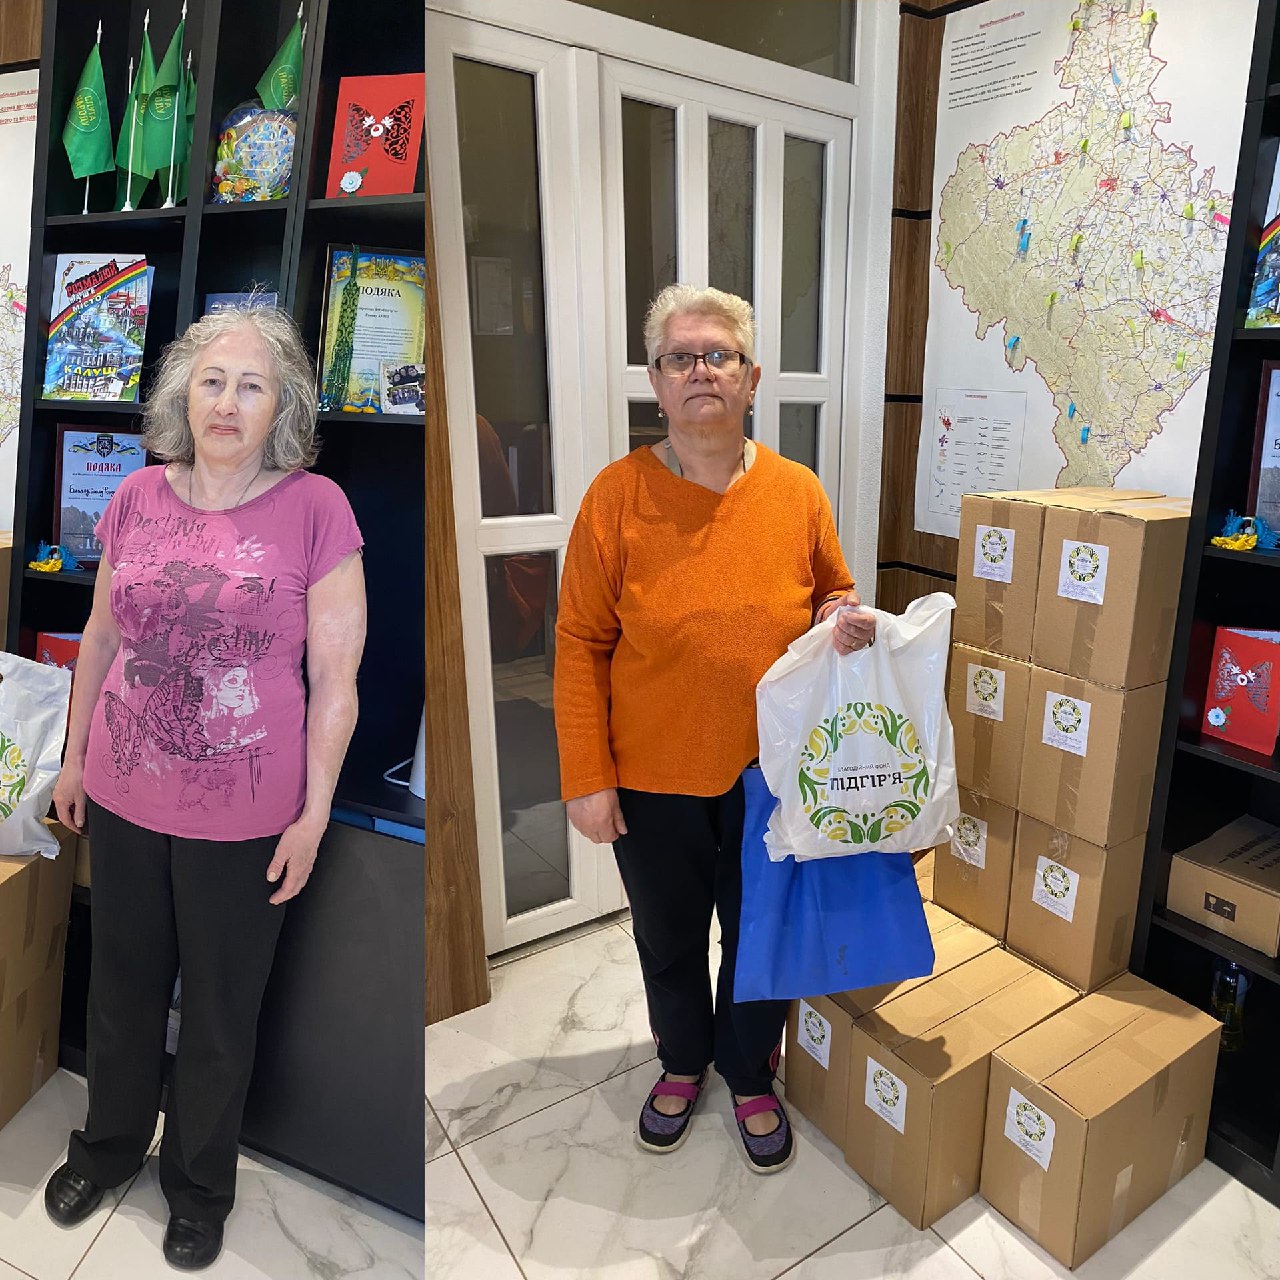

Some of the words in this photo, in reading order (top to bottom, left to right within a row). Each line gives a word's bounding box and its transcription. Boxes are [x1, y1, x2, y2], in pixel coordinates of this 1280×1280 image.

[66, 262, 119, 297] РОЗМАЛЮЙ
[64, 365, 117, 376] КАЛУШ
[86, 462, 122, 473] ПОДЯКА
[830, 772, 904, 792] ПІДГІР'Я
